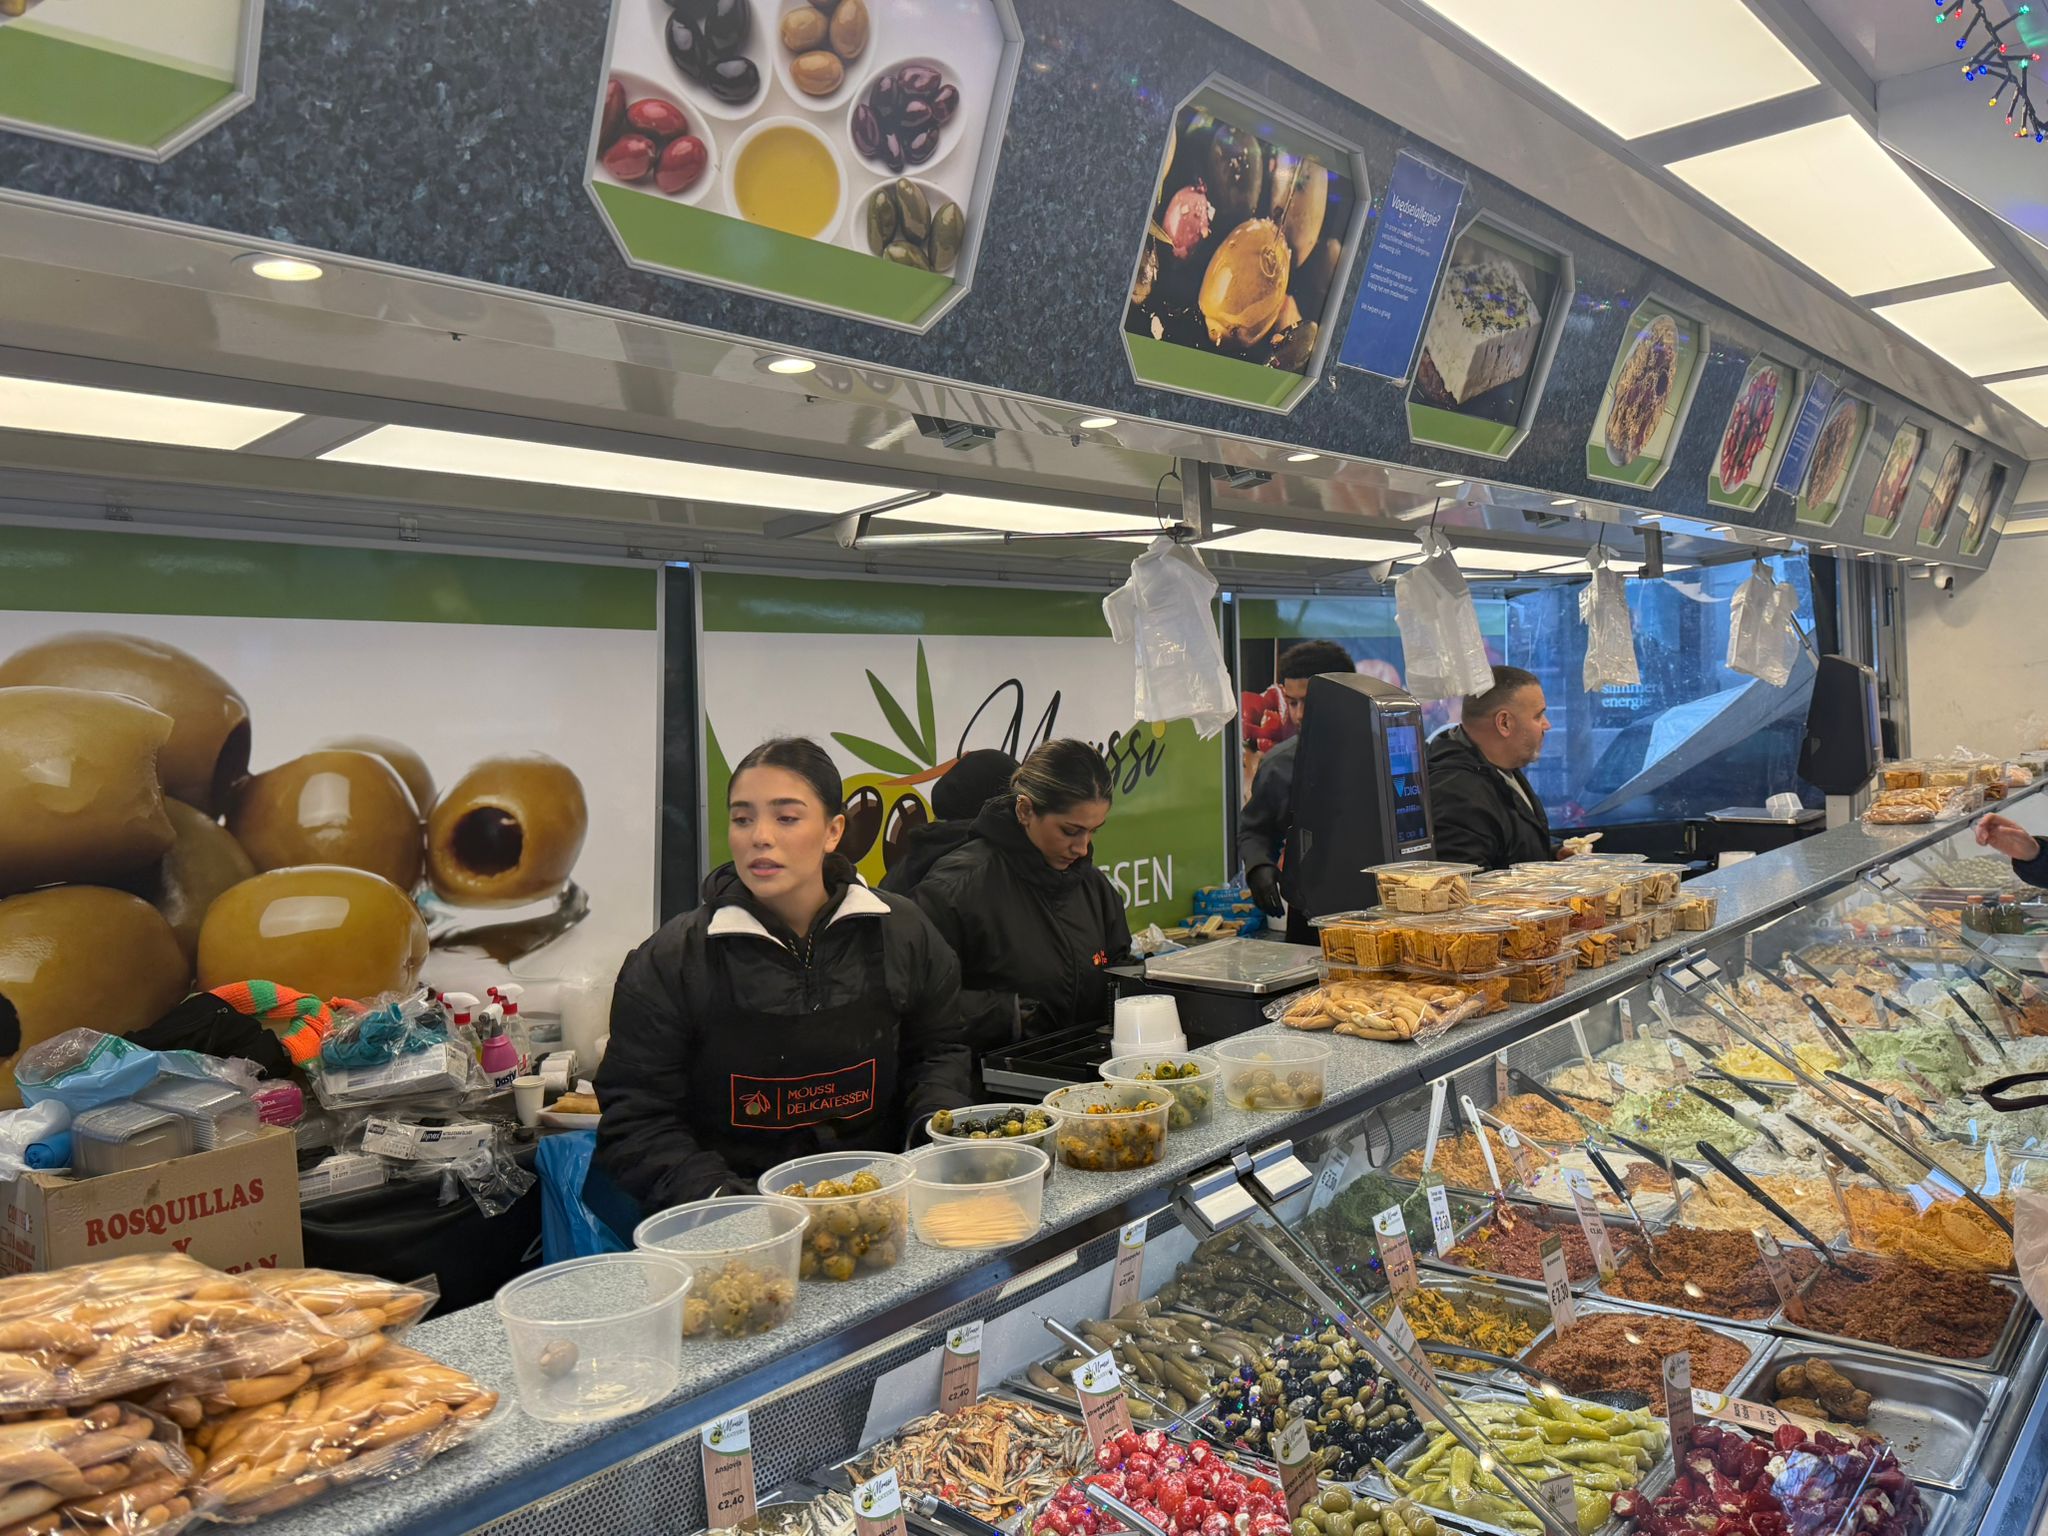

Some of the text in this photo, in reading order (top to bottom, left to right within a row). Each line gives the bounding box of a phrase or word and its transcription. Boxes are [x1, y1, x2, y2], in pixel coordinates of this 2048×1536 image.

[1602, 697, 1652, 711] energie
[787, 1083, 835, 1100] MOUSSI
[787, 1089, 869, 1115] DELICATESSEN
[86, 1178, 264, 1247] ROSQUILLAS
[714, 1460, 742, 1475] Ansjovis
[717, 1494, 745, 1511] €2,40
